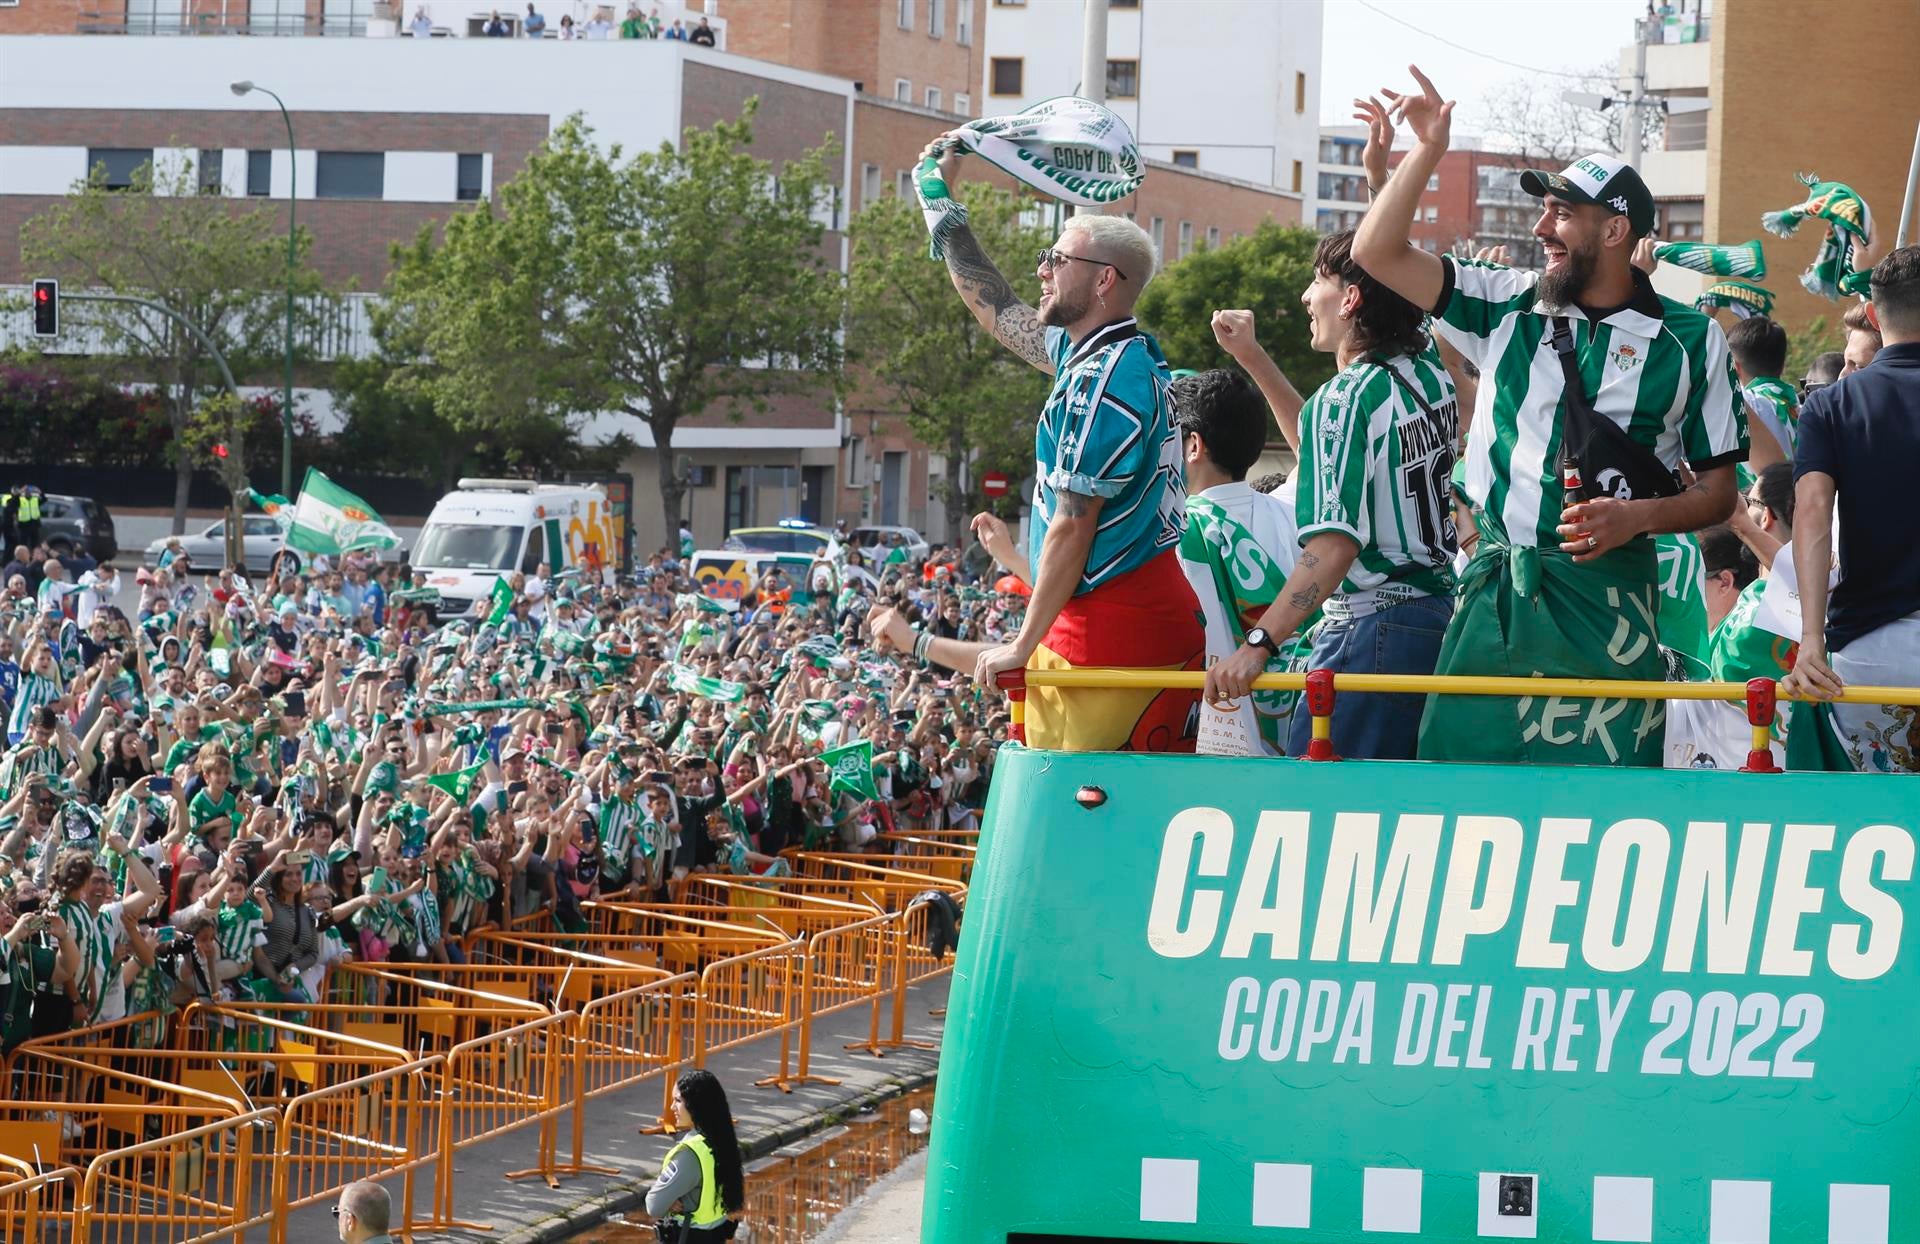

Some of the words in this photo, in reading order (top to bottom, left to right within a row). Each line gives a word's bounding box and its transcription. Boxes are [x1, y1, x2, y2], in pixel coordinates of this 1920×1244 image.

[1201, 713, 1244, 728] INAL
[1148, 806, 1915, 980] CAMPEONES
[1219, 976, 1376, 1064] COPA
[1394, 983, 1492, 1068] DEL
[1513, 987, 1634, 1072] REY
[1641, 990, 1825, 1078] 2022
